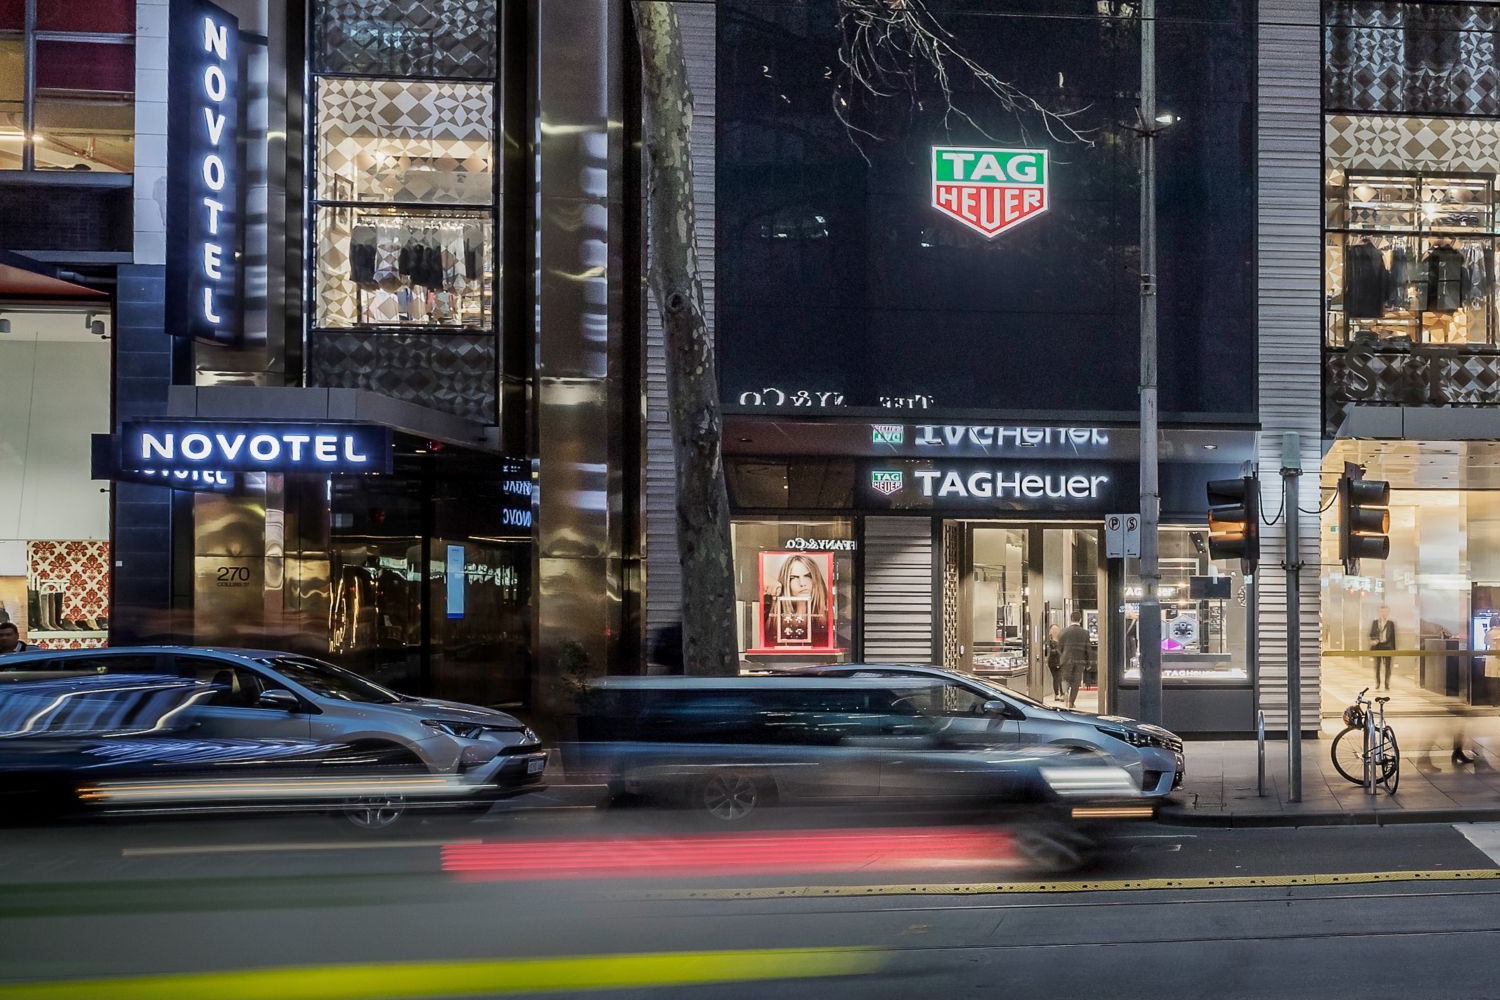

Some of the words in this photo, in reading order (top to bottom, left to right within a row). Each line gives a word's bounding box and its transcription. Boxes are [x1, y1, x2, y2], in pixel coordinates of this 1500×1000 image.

[204, 17, 227, 324] NOVOTEL
[942, 152, 1037, 182] TAG
[939, 187, 1041, 230] HEUER
[141, 433, 367, 462] NOVOTEL
[874, 473, 900, 481] TAG
[874, 481, 901, 493] HEUER
[217, 566, 250, 582] 270
